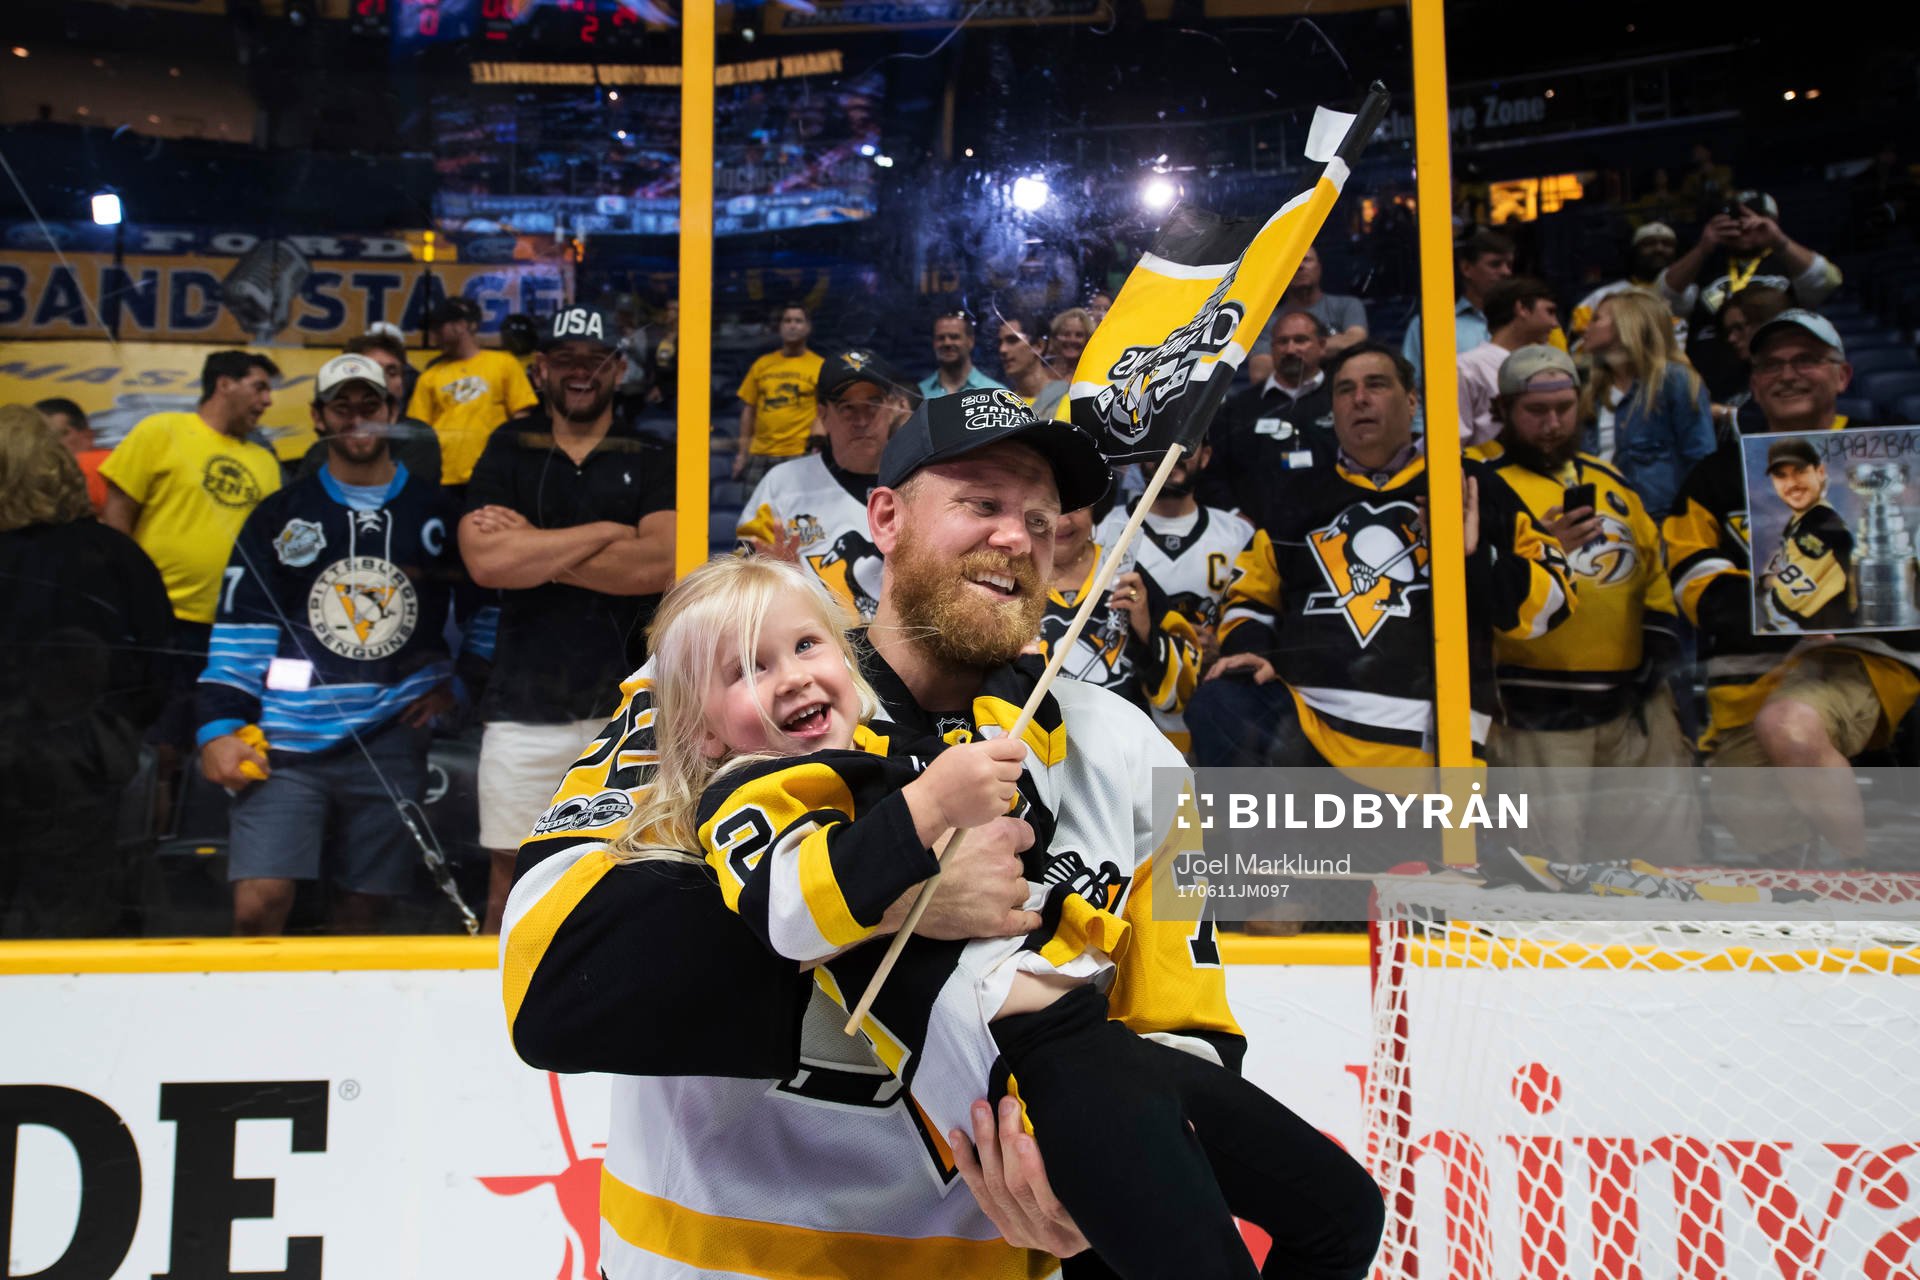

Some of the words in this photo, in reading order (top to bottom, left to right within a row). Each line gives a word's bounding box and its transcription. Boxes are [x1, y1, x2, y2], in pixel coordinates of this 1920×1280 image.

[1482, 97, 1546, 127] Zone
[0, 265, 222, 332] BAND
[297, 268, 564, 334] STAGE
[553, 308, 604, 339] USA
[961, 394, 990, 407] 20
[422, 518, 446, 556] C
[310, 559, 416, 610] PITTSBURGH
[1207, 553, 1227, 591] C
[1777, 564, 1817, 597] 87
[315, 623, 414, 659] PENGUINS
